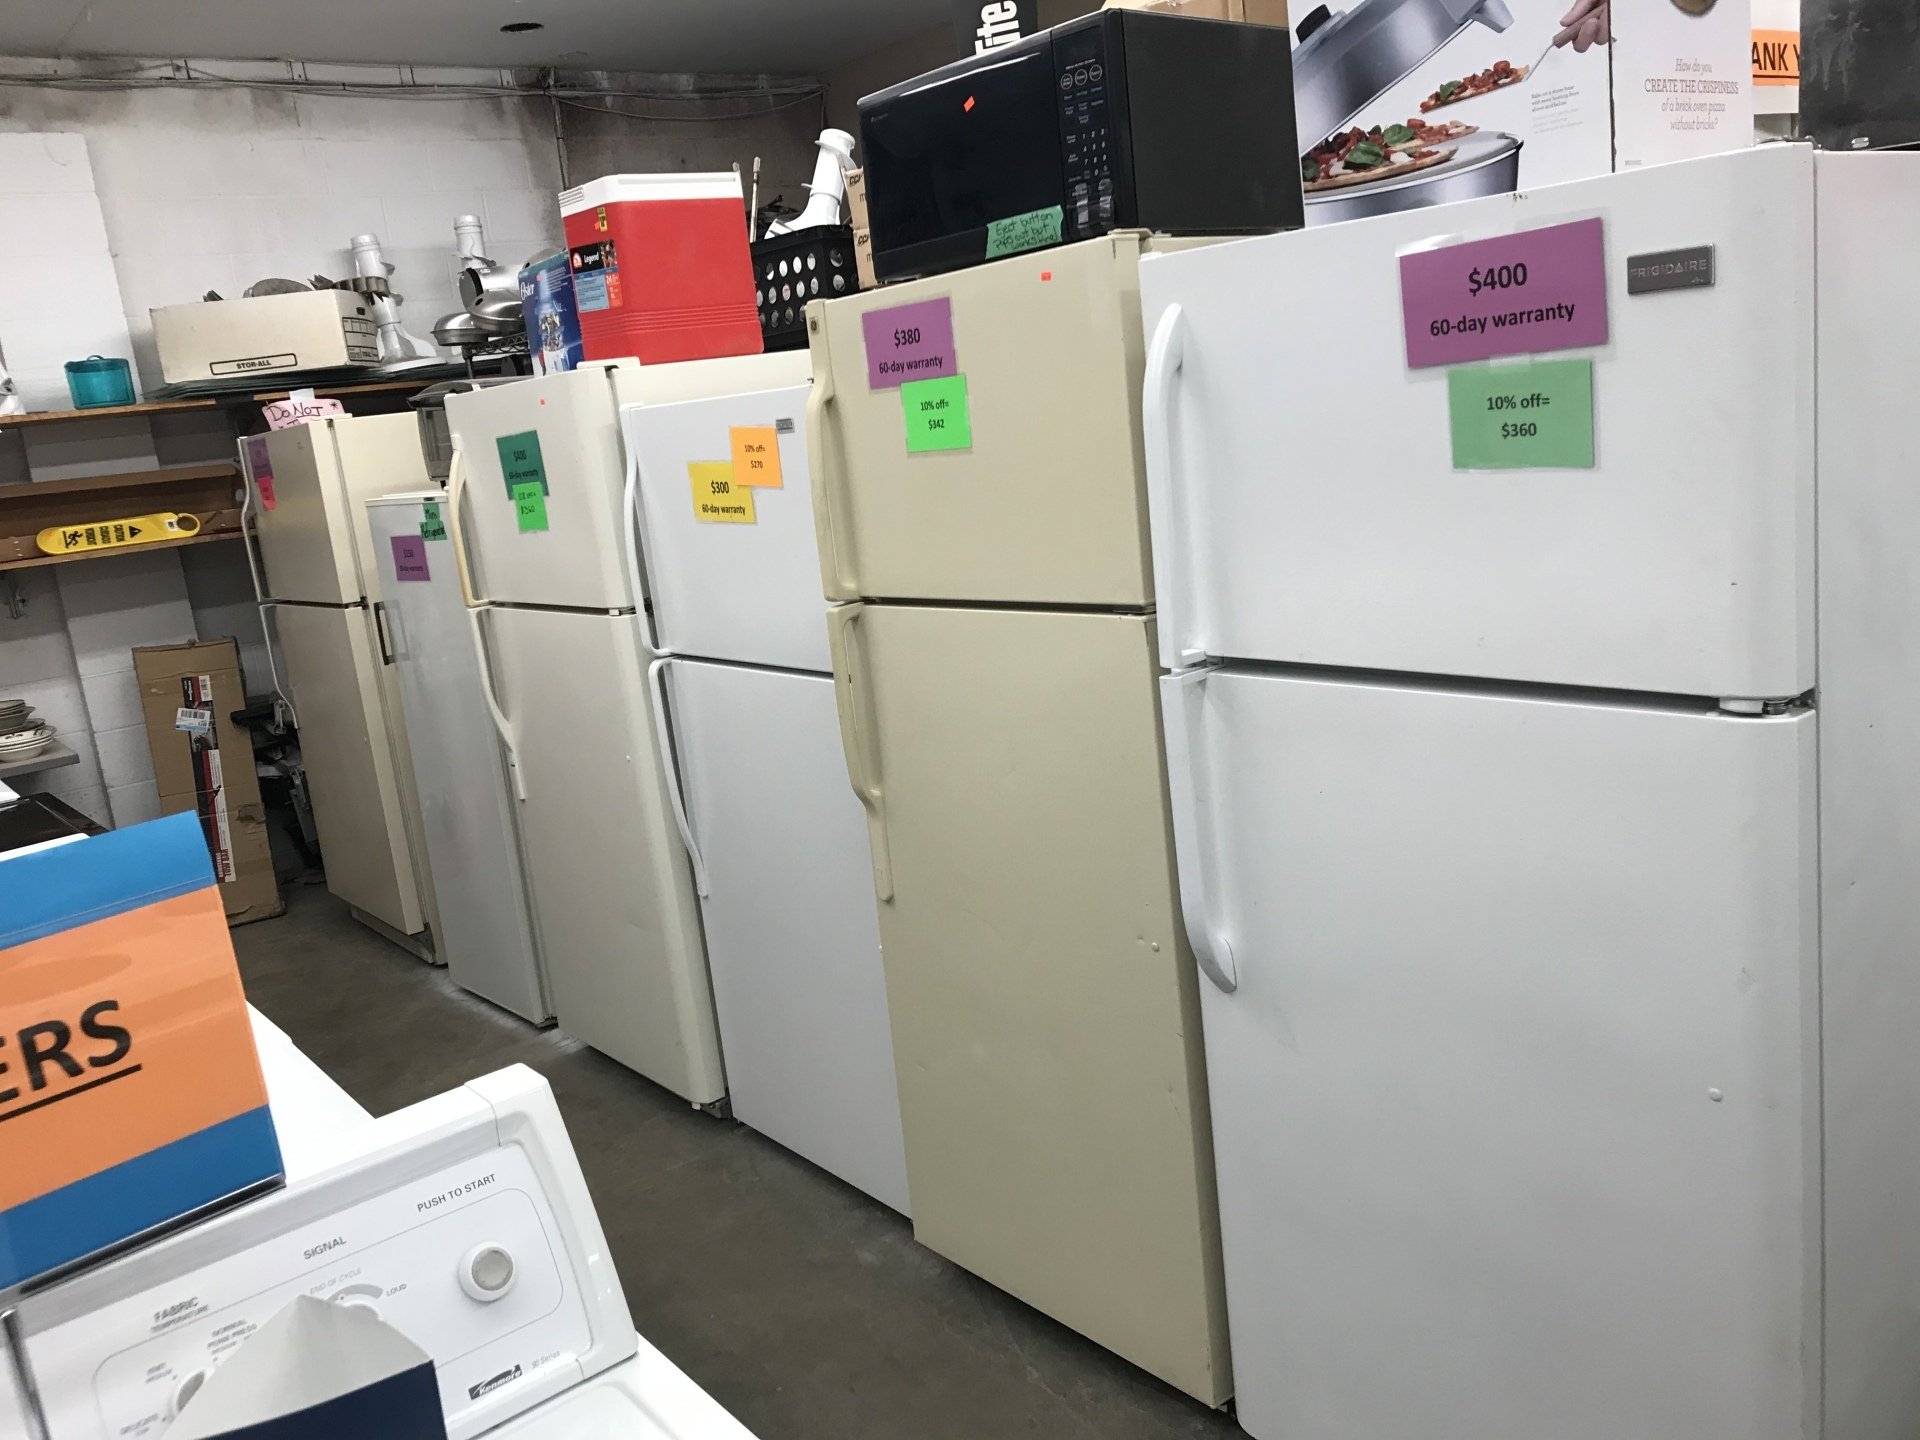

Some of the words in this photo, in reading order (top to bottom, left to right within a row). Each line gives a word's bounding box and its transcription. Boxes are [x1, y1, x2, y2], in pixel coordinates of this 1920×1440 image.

[1752, 41, 1789, 71] ANK
[1675, 58, 1691, 71] How
[1692, 58, 1700, 72] do
[1701, 63, 1712, 75] you
[1644, 78, 1678, 93] CREATE
[1680, 79, 1696, 93] THE
[1697, 79, 1738, 94] CRISPINESS
[1661, 97, 1670, 112] of
[1675, 97, 1692, 112] brick
[1693, 102, 1707, 112] oven
[1708, 103, 1725, 115] pizza
[1670, 116, 1695, 130] without
[1696, 115, 1718, 130] bricks?
[1020, 211, 1054, 228] button
[583, 251, 600, 264] Legend
[1630, 259, 1707, 279] FRIGIDAIRE
[1468, 263, 1528, 297] $400
[520, 281, 535, 301] Oster
[1430, 315, 1487, 336] 60-day
[1492, 303, 1575, 328] warranty
[894, 328, 921, 349] $380
[236, 359, 272, 370] STOR-ALL
[879, 360, 905, 374] 60-day
[906, 355, 943, 371] warranty
[920, 400, 935, 411] 10%
[935, 399, 949, 410] off=
[1487, 395, 1517, 410] 10%
[1520, 393, 1550, 408] off=
[267, 405, 291, 422] Do
[293, 402, 323, 417] NOT
[928, 418, 945, 431] $342
[1501, 422, 1537, 440] $360
[744, 444, 755, 453] 10%
[711, 480, 730, 496] $300
[702, 504, 720, 515] 60-day
[721, 505, 746, 516] warranty
[99, 525, 111, 544] CUIDADO
[113, 524, 125, 542] CAUTION
[417, 1194, 447, 1213] PUSH
[448, 1187, 463, 1201] TO
[464, 1173, 496, 1193] START
[303, 1236, 347, 1260] SIGNAL
[310, 1283, 327, 1295] END
[327, 1279, 337, 1288] OF
[338, 1267, 362, 1283] CYCLE
[386, 1283, 407, 1298] LOUD
[153, 1296, 199, 1322] FABRIC
[479, 1369, 521, 1396] Kenmore
